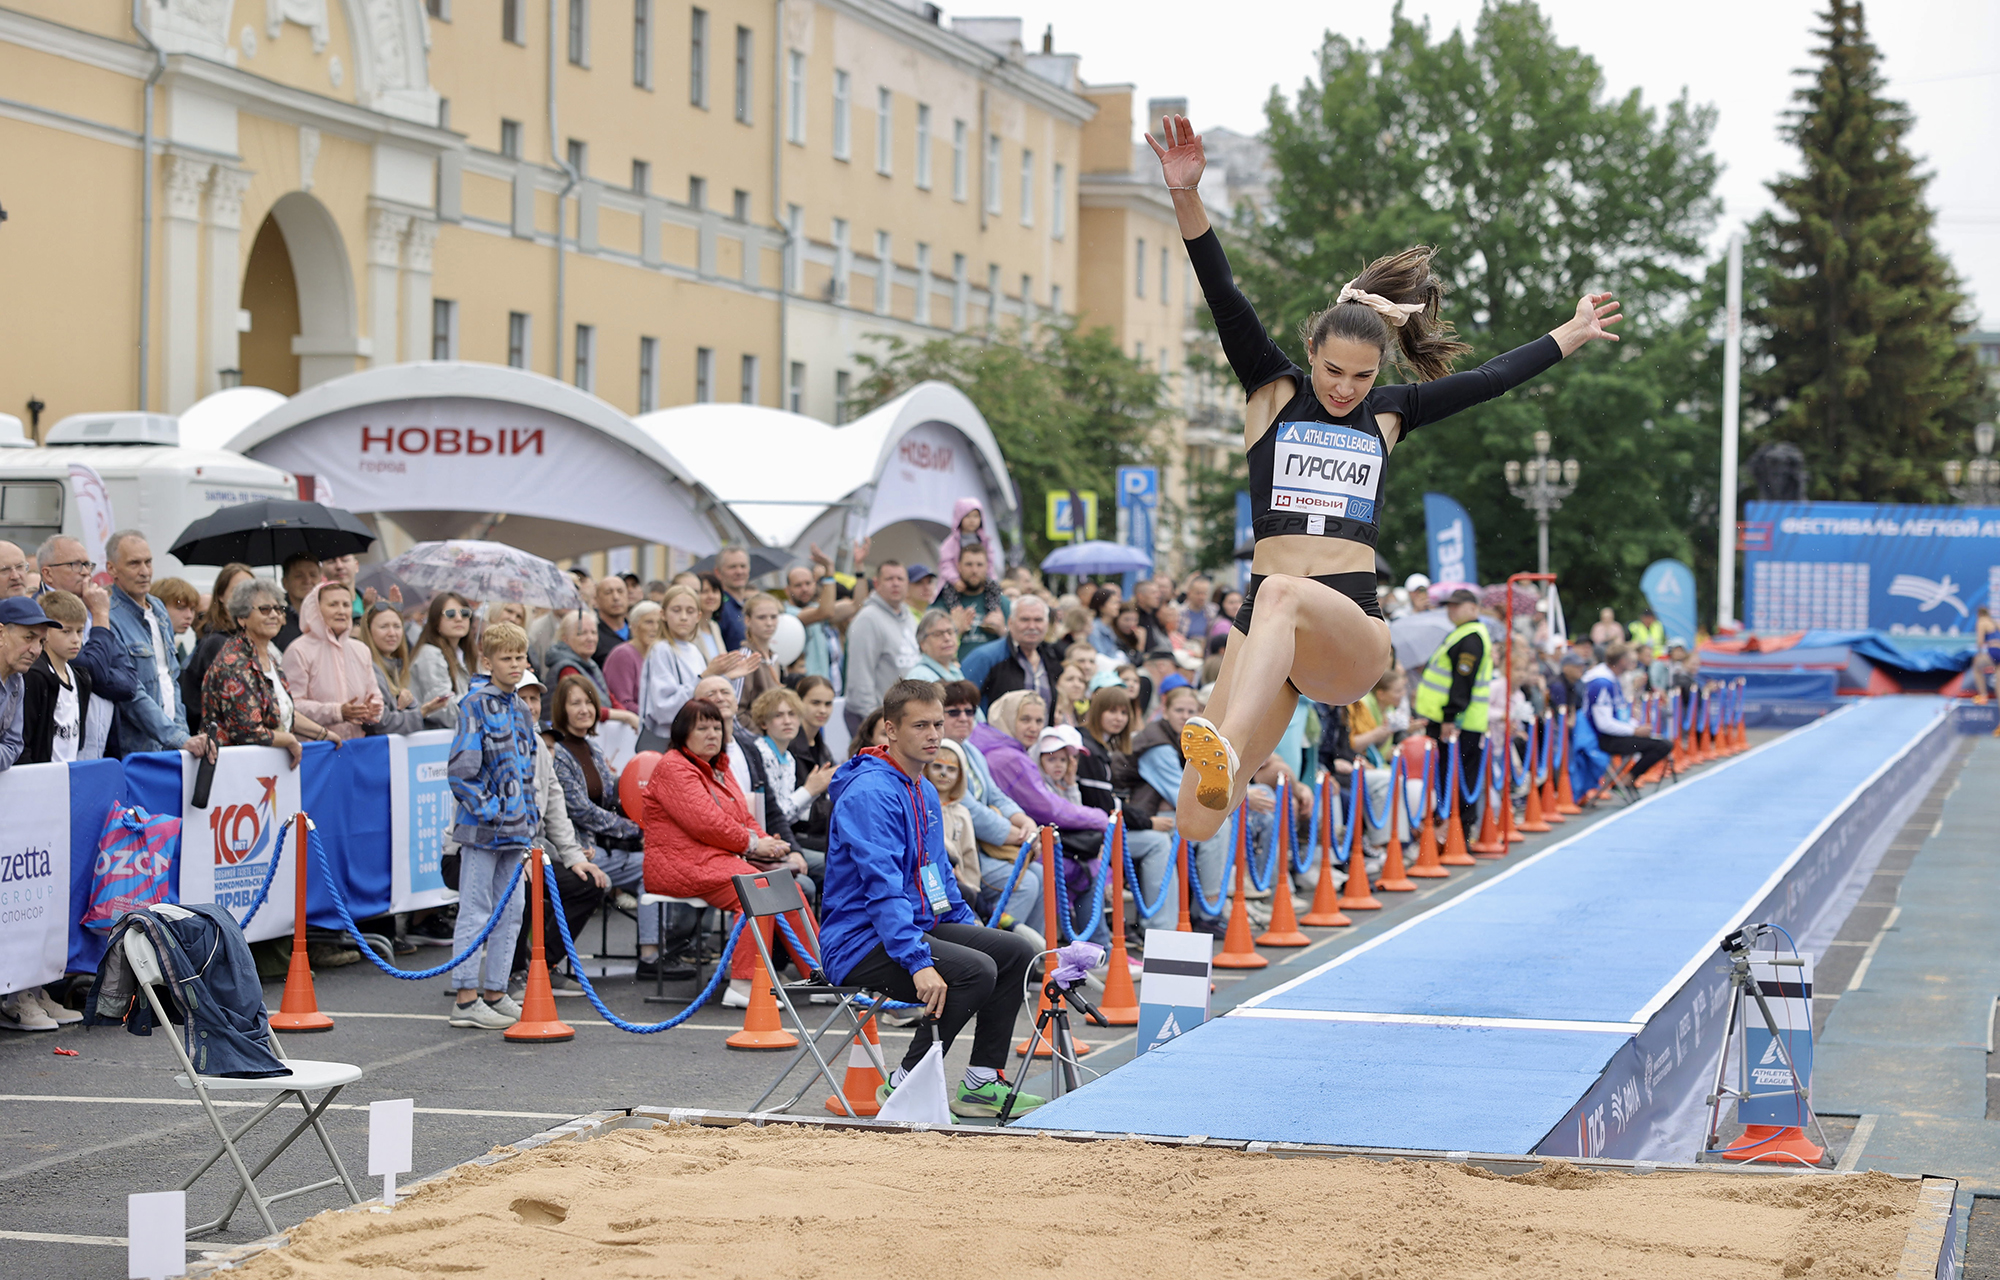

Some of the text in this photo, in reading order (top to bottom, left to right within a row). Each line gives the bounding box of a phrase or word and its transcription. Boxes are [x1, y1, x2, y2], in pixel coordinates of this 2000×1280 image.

[361, 426, 545, 457] НОВЫЙ
[1303, 429, 1376, 454] ATHLETICS LEAGUE
[360, 459, 407, 475] город
[1285, 453, 1371, 486] ГУРСКАЯ
[1296, 496, 1343, 509] НОВЫЙ
[1348, 500, 1371, 518] 07
[1780, 517, 1899, 537] ФЕСТИВАЛЬ
[1901, 516, 1979, 537] ЛЕГКОЙ
[428, 766, 447, 778] Tveris
[210, 804, 260, 865] 100
[234, 841, 247, 851] ЛЕТ
[1, 846, 52, 883] zetta
[215, 878, 264, 891] КОМСОМОЛЬСКА
[1, 885, 53, 905] GROUP
[2, 906, 44, 924] СПОНСОР
[1588, 1103, 1606, 1158] ПСБ
